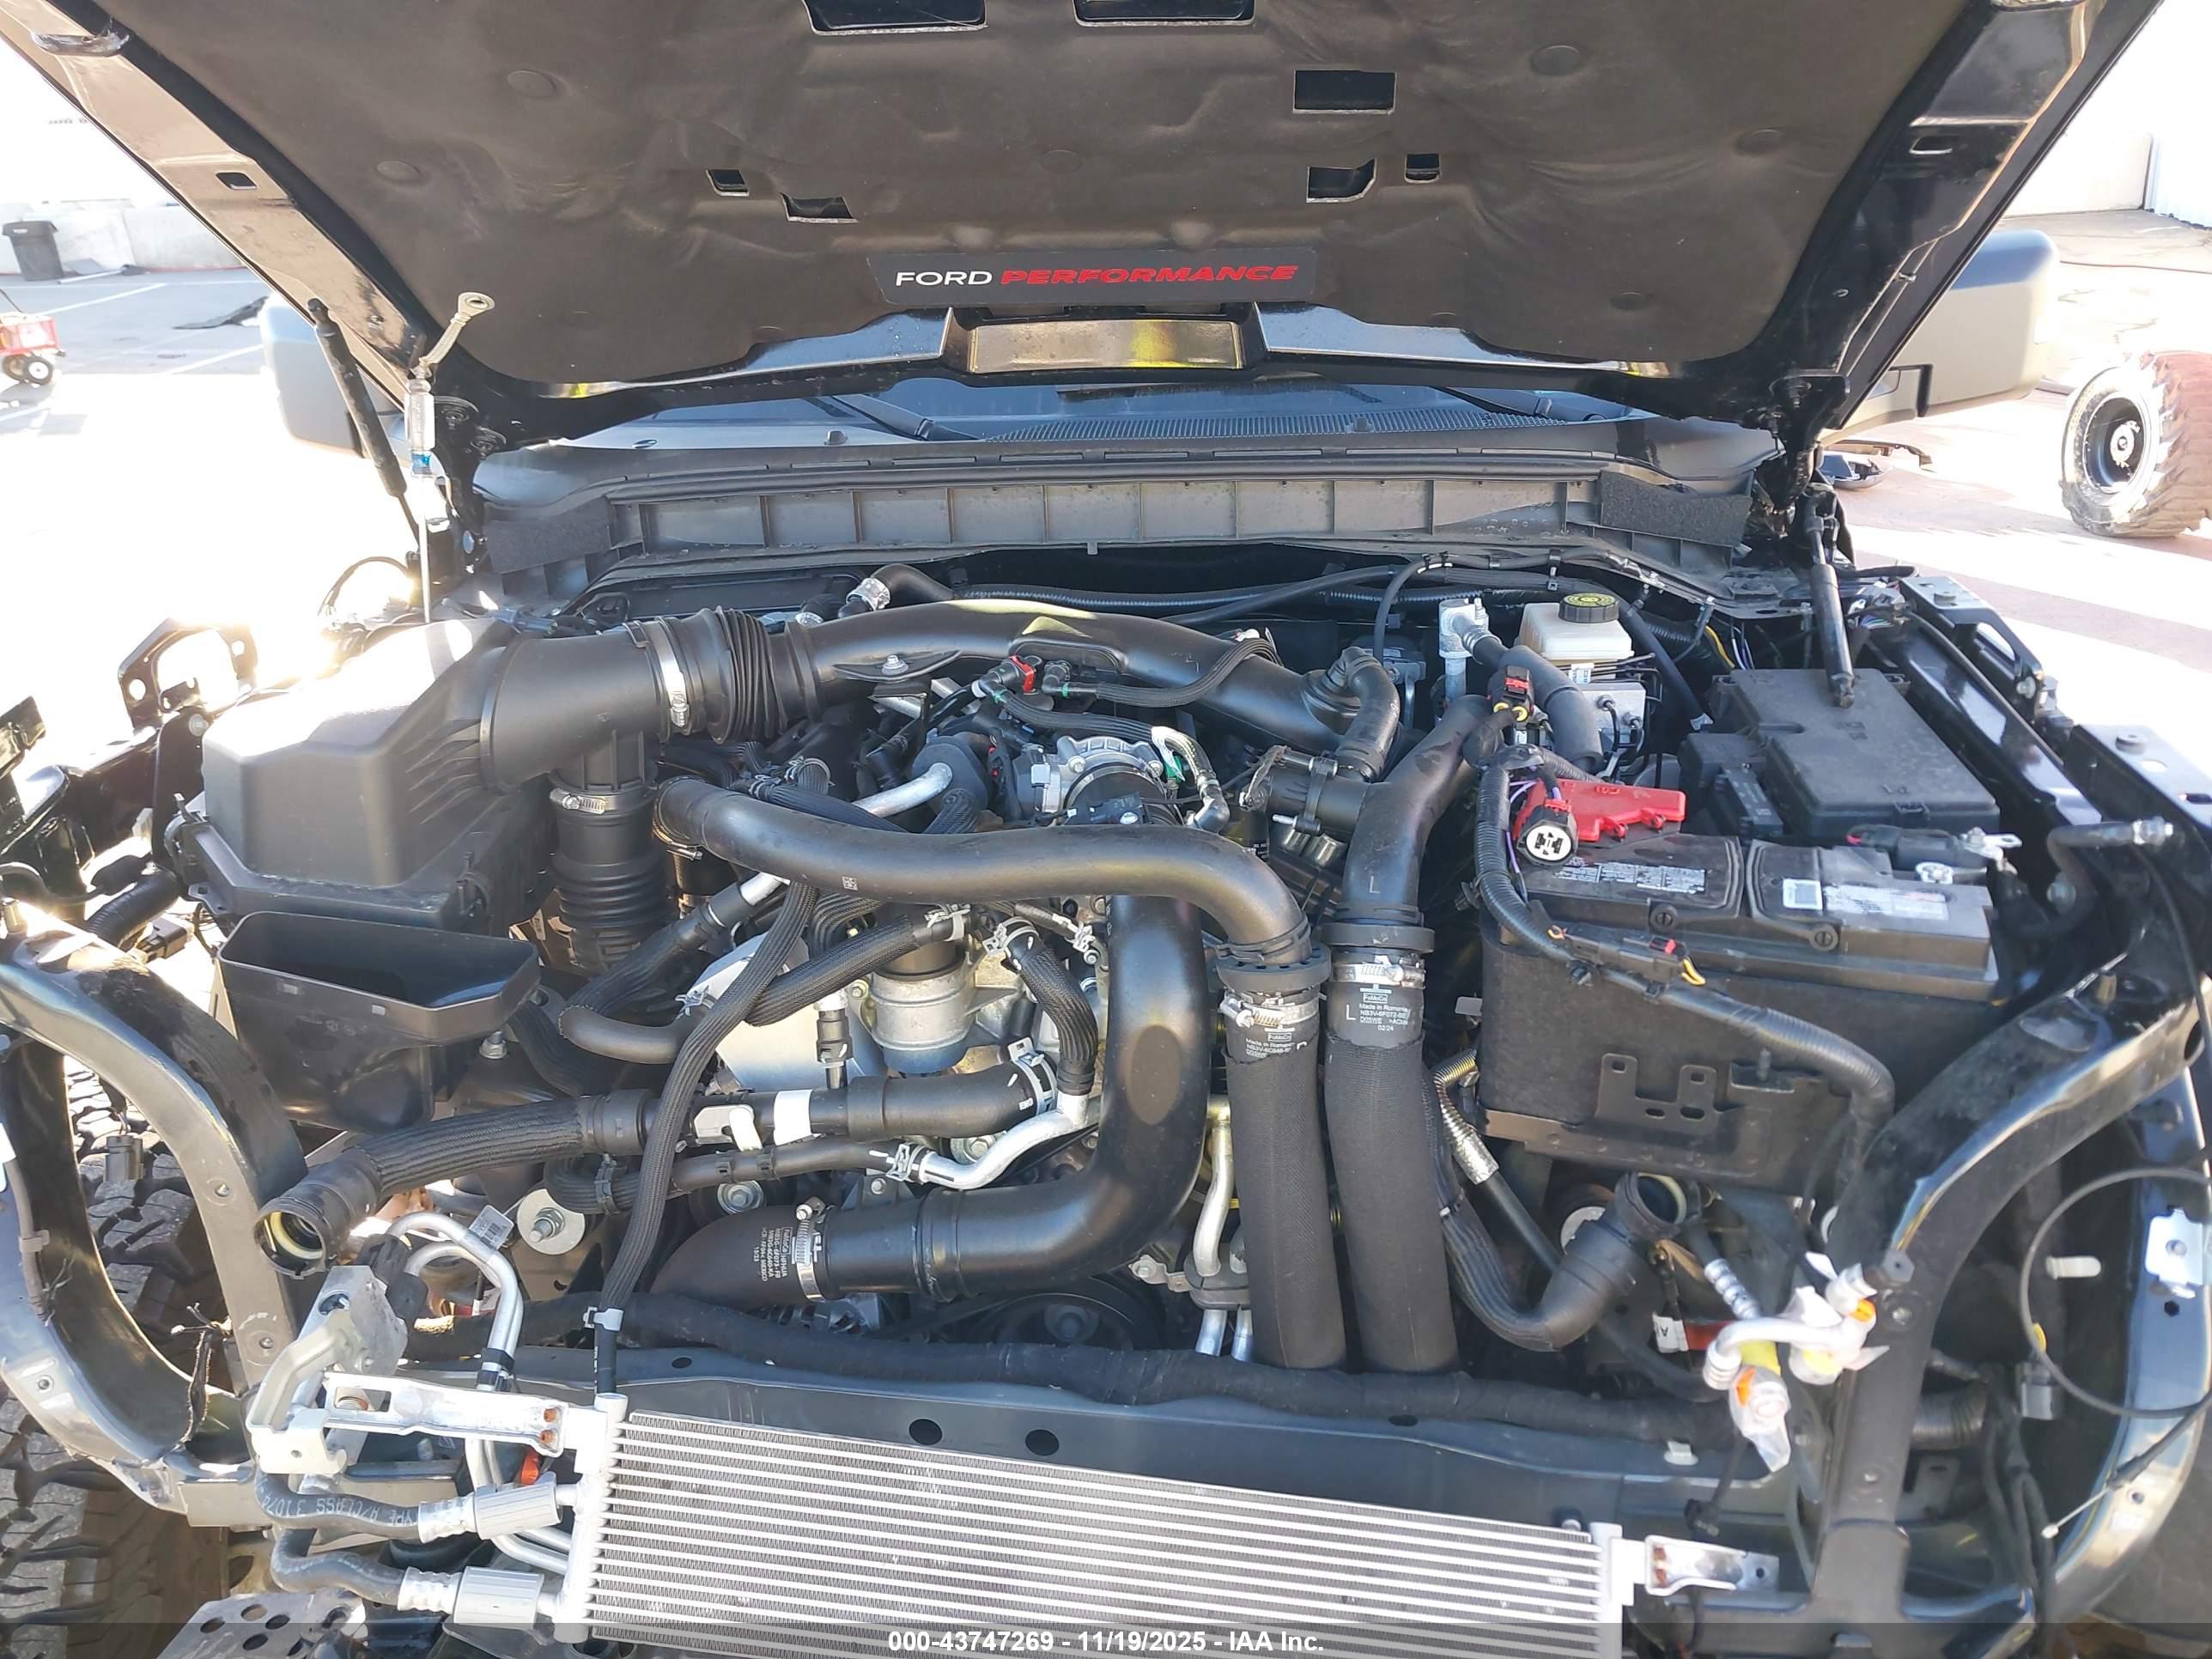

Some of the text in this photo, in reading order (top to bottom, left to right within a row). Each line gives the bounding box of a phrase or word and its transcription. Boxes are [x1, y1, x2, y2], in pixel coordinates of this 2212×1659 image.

[896, 266, 1297, 286] FORD PERFORMANCE
[1369, 875, 1382, 894] L
[1346, 1004, 1356, 1020] L
[390, 1509, 413, 1526] YPE
